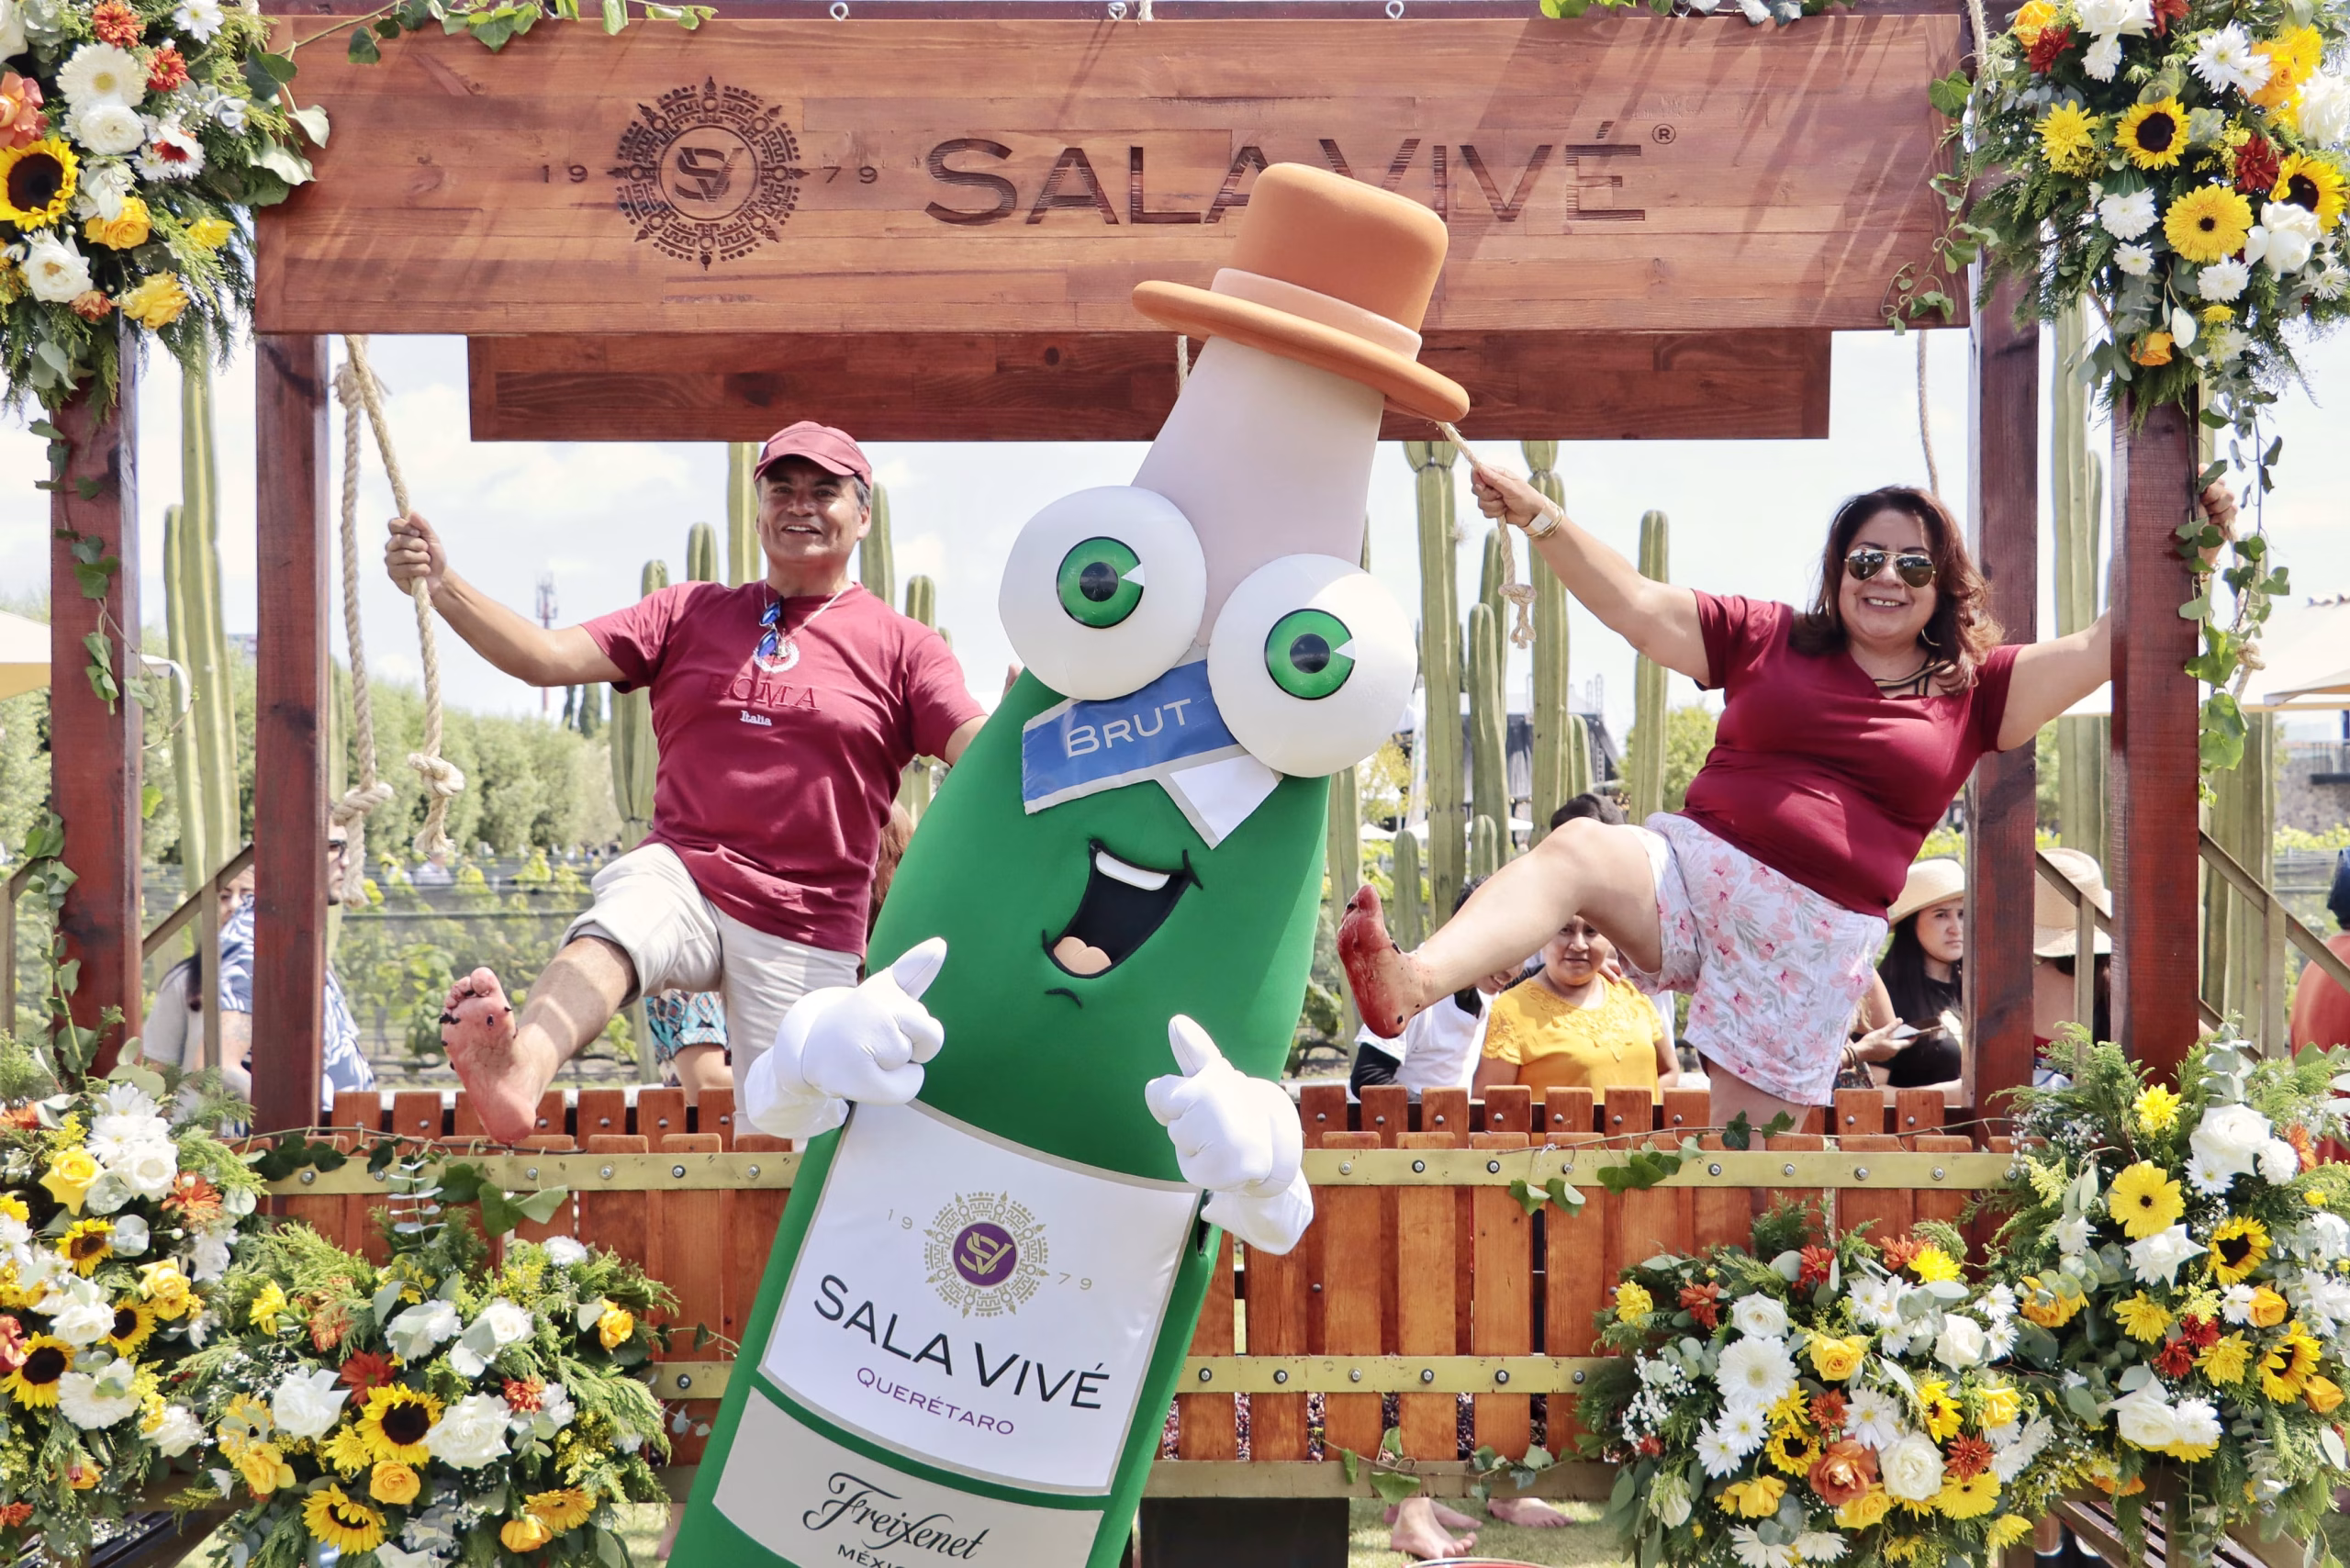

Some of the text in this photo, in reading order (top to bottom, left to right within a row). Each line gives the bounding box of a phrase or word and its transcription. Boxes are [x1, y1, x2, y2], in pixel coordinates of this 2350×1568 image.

[924, 138, 1270, 227] SALA
[739, 710, 773, 727] Italia
[1066, 698, 1192, 758] BRUT
[813, 1274, 1111, 1410] SALA VIVÉ
[856, 1366, 1015, 1436] QUERÉTARO
[801, 1472, 991, 1561] Freixenet
